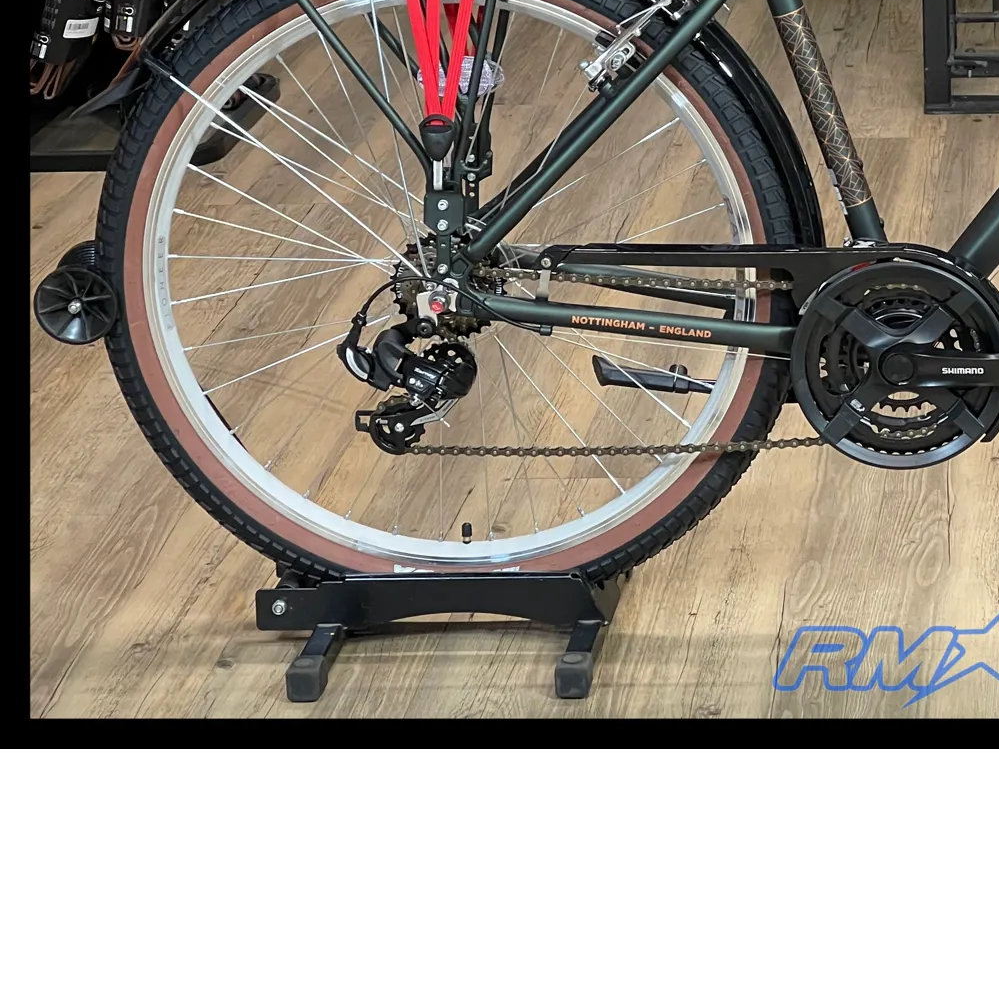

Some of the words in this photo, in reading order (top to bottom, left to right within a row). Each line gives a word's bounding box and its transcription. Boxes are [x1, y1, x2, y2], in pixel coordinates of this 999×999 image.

[572, 315, 645, 330] NOTTINGHAM
[659, 325, 712, 338] ENGLAND
[941, 366, 984, 375] SHIMANO
